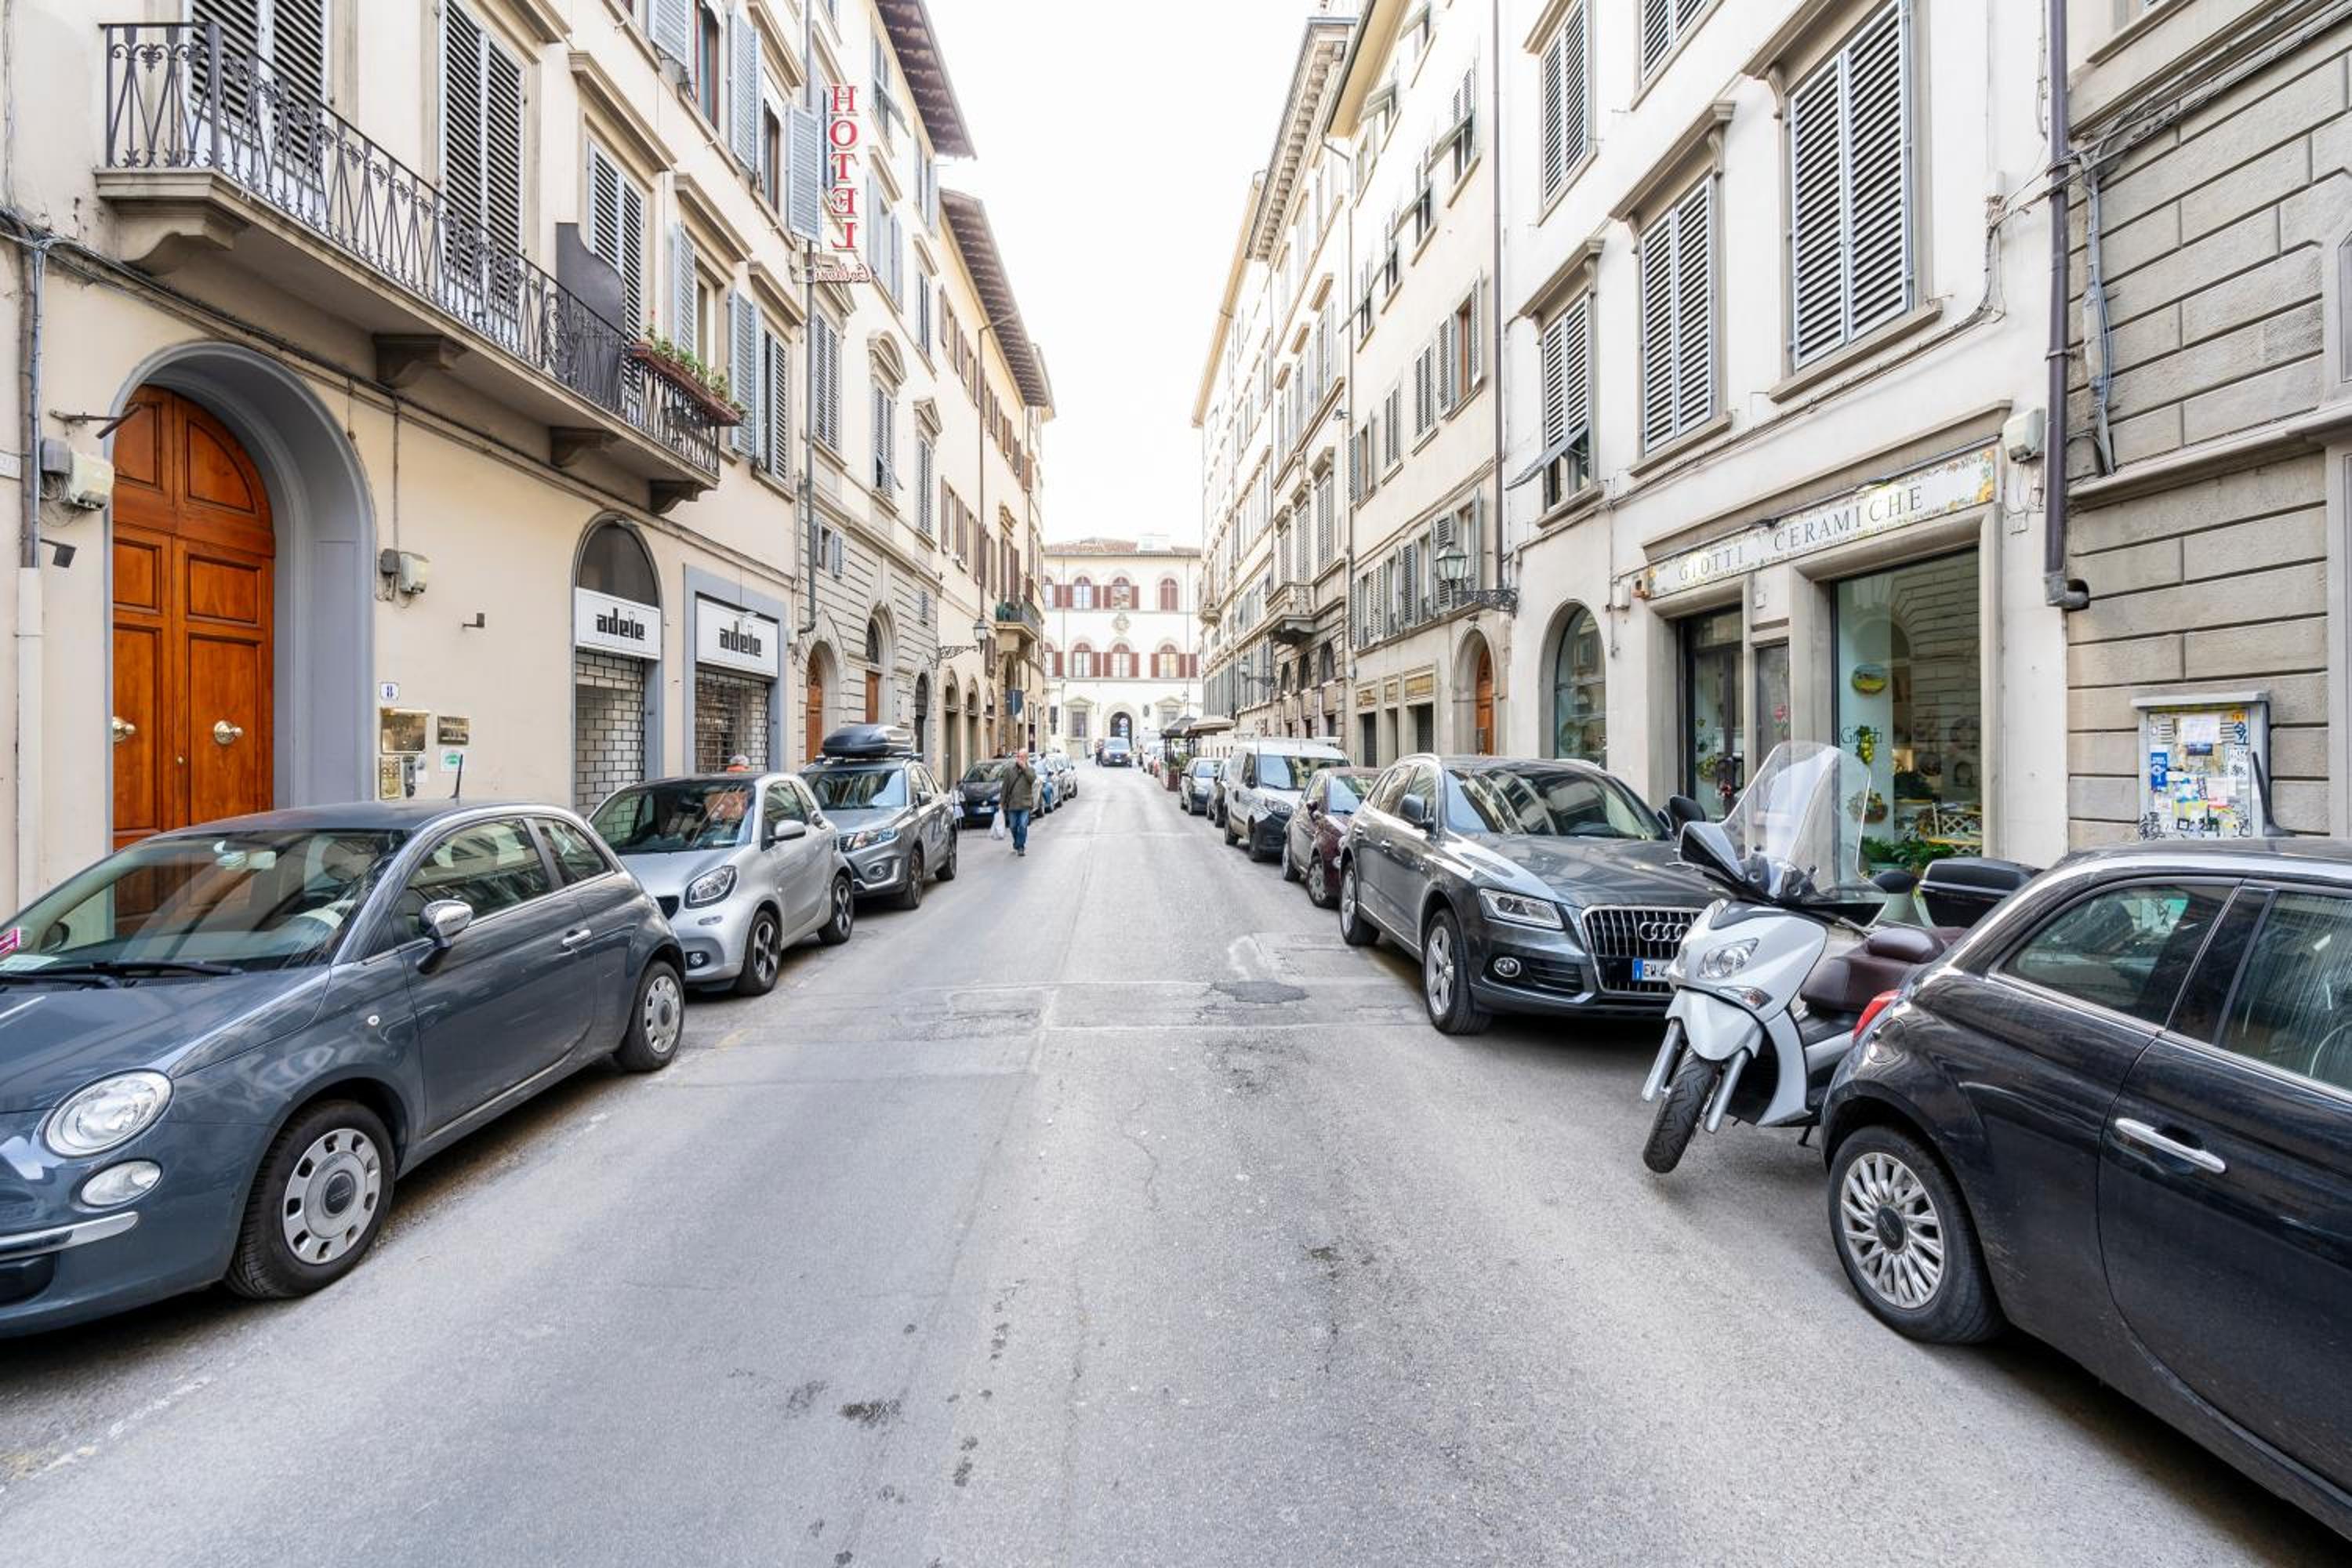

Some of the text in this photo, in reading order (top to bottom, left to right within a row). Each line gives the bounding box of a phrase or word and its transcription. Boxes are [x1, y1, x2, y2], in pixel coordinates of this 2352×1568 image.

[1679, 485, 1922, 581] GIOTTI CERAMICHE
[596, 608, 645, 641] adele
[719, 621, 761, 658] adele
